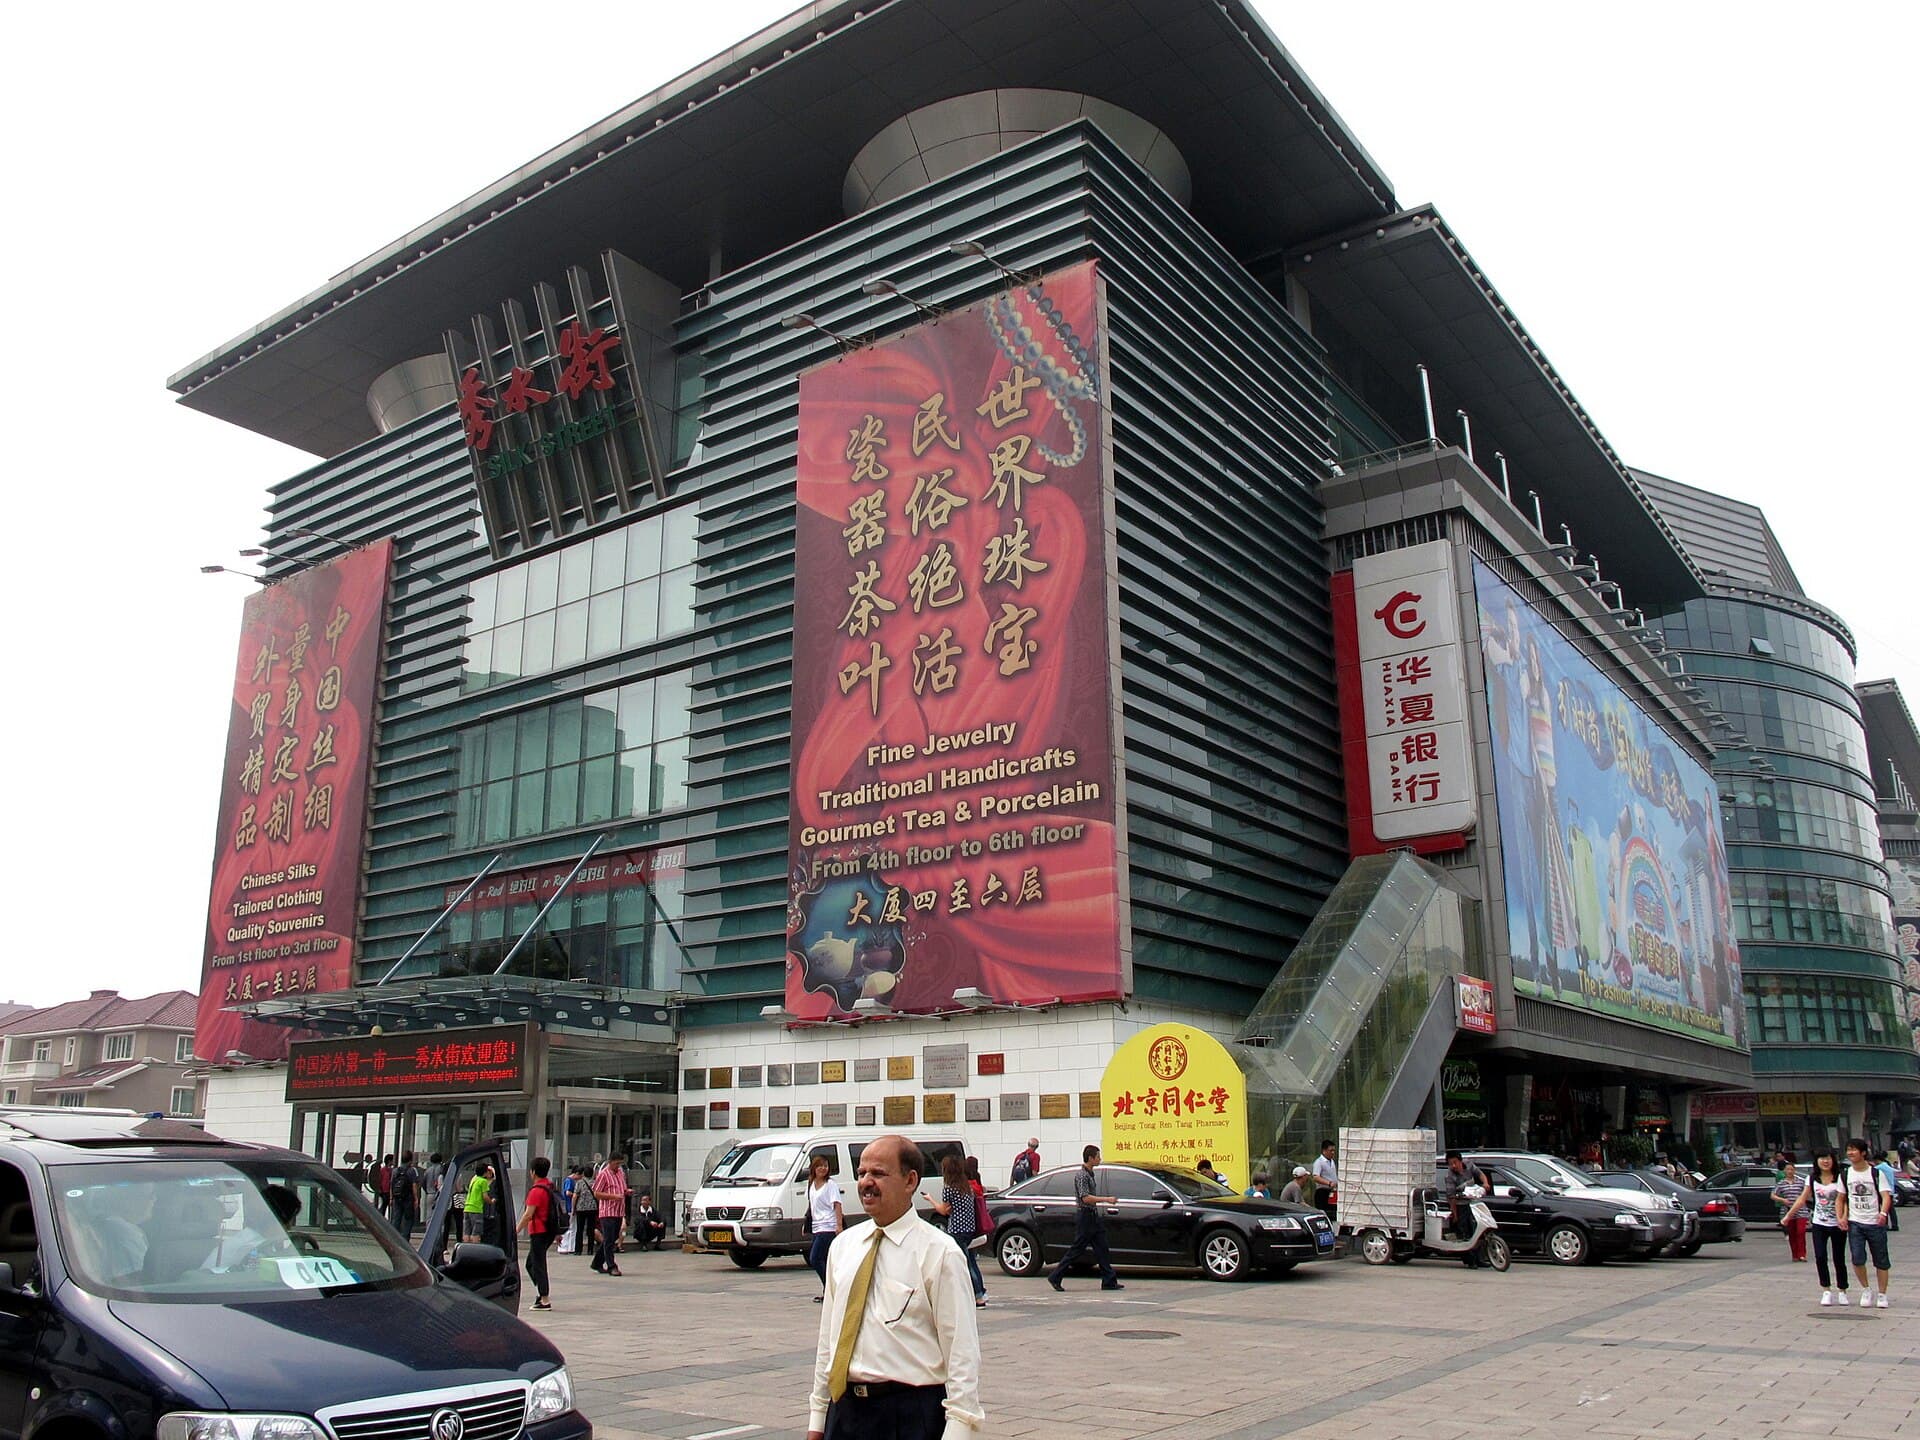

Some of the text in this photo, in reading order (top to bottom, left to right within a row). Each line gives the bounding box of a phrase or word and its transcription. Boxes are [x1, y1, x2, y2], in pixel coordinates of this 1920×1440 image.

[487, 404, 616, 478] SILK STREET
[904, 392, 968, 696] 民俗绝活
[976, 365, 1047, 676] 世界珠宝
[837, 414, 898, 716] 瓷器茶叶
[234, 634, 280, 852] 外贸精品
[262, 622, 311, 845] 量身定制
[302, 605, 351, 832] 中国丝绸
[867, 720, 1017, 767] Fine Jewelry
[1382, 662, 1402, 802] HUAXIA BANK
[1396, 655, 1441, 803] 华夏银行
[819, 747, 1077, 810] Traditional Handicrafts
[800, 780, 1100, 846] Gourmet Tea & Porcelain
[241, 863, 316, 890] Chinese Silks
[624, 859, 645, 875] Red
[811, 822, 1084, 880] From 4th floor to 6th floor
[233, 890, 323, 917] Tailored Clothing
[847, 866, 1045, 926] 大厦四至六层
[211, 937, 338, 968] From 1st floor to 3rd floor
[227, 914, 325, 942] Quality Souvenirs
[225, 965, 316, 1001] 大厦一至三层
[1579, 969, 1597, 997] The
[1113, 1086, 1230, 1118] 北京同仁堂
[1114, 1119, 1230, 1131] Beijing Tong Ren Tang Pharmacy
[1159, 1154, 1174, 1164] (On
[1178, 1153, 1190, 1163] the
[1212, 1152, 1234, 1163] floor)
